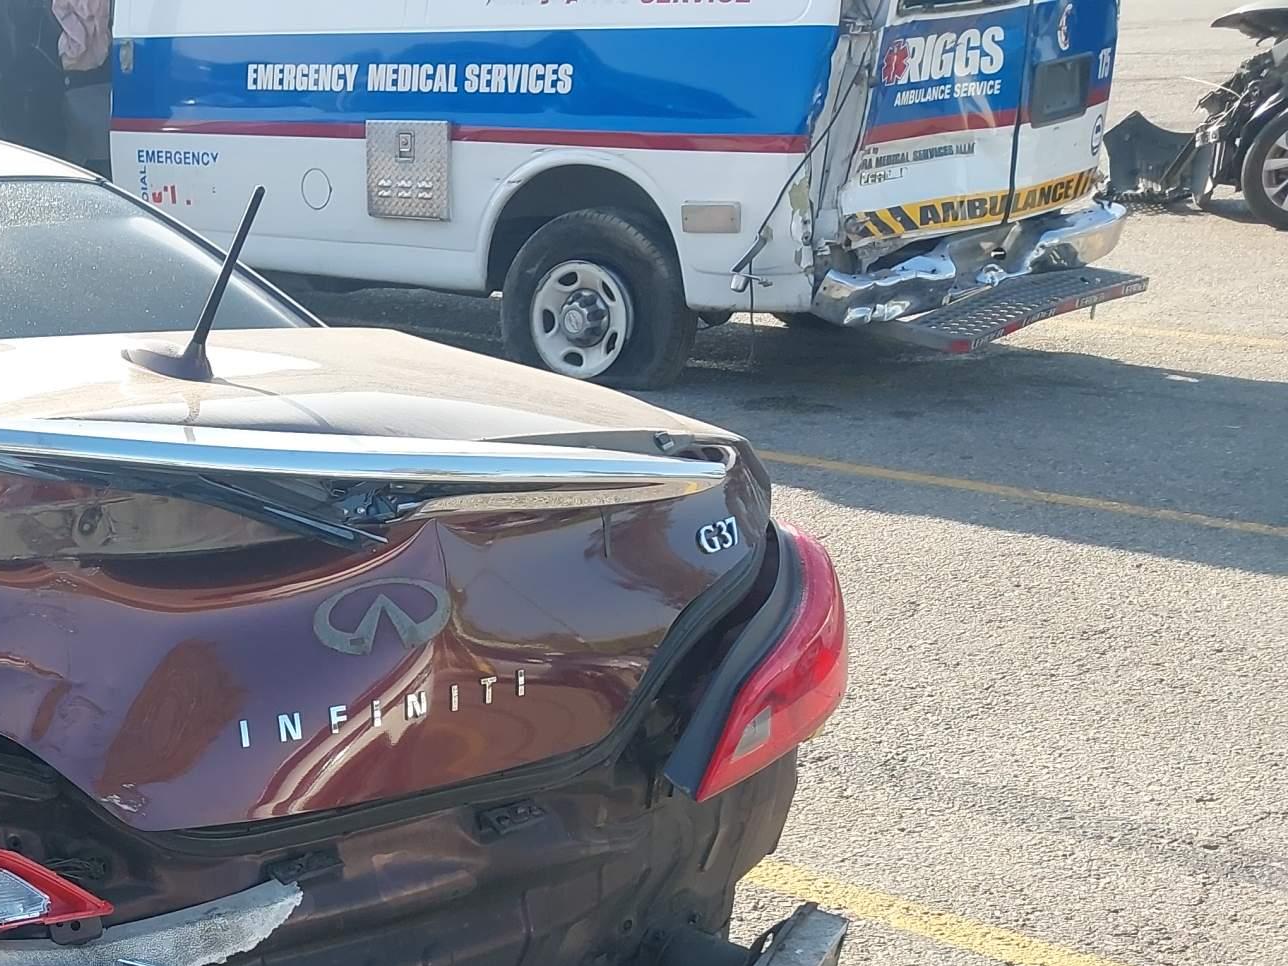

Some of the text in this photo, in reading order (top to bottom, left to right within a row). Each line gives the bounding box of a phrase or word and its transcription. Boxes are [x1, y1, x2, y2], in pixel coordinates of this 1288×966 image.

[897, 26, 1005, 85] RIGGS
[247, 63, 574, 94] EMERGENCY MEDICAL SERVICES
[893, 79, 1002, 107] AMBULANCE SERVICE
[137, 149, 219, 167] EMERGENCY
[919, 180, 1076, 226] AMBULANCE
[696, 515, 739, 554] G37
[239, 669, 527, 748] INFINITI
